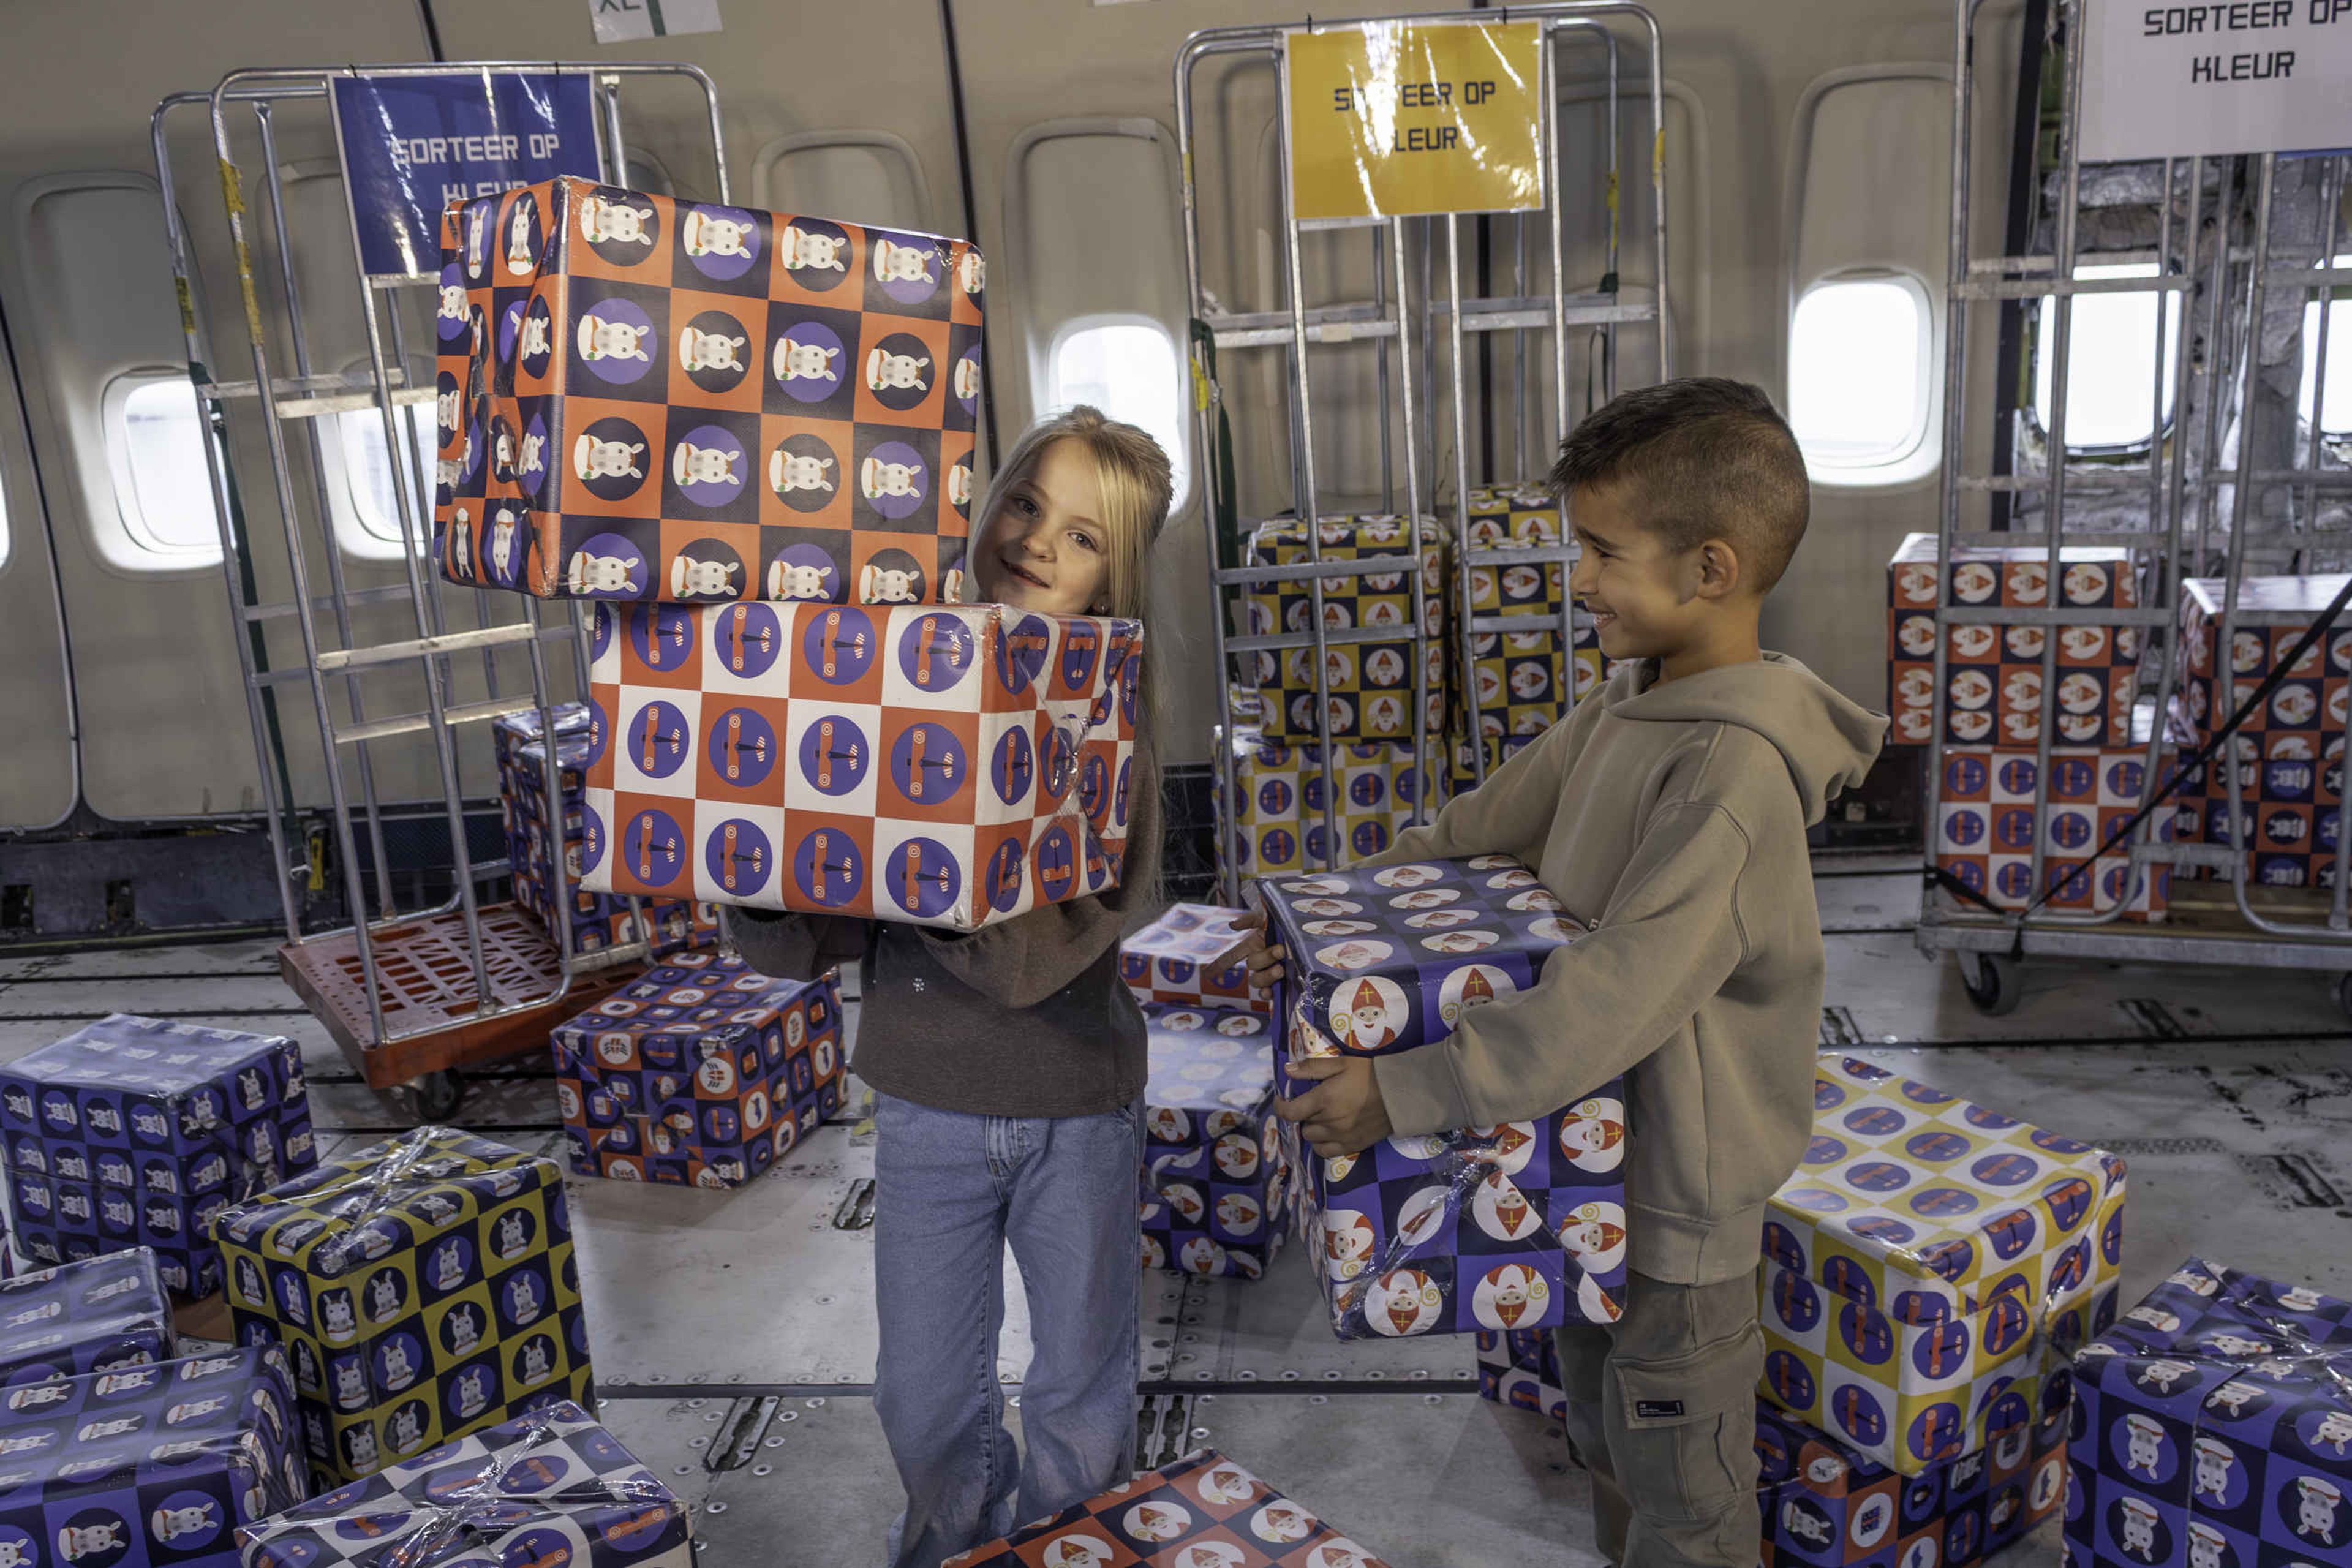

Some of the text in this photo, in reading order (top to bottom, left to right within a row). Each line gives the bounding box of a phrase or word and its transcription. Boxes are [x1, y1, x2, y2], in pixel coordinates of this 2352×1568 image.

[2144, 0, 2352, 36] SORTEER OP
[2192, 51, 2296, 83] KLEUR
[1464, 81, 1496, 104] OP
[392, 134, 559, 164] SORTEER OP
[1395, 127, 1458, 152] LEUR
